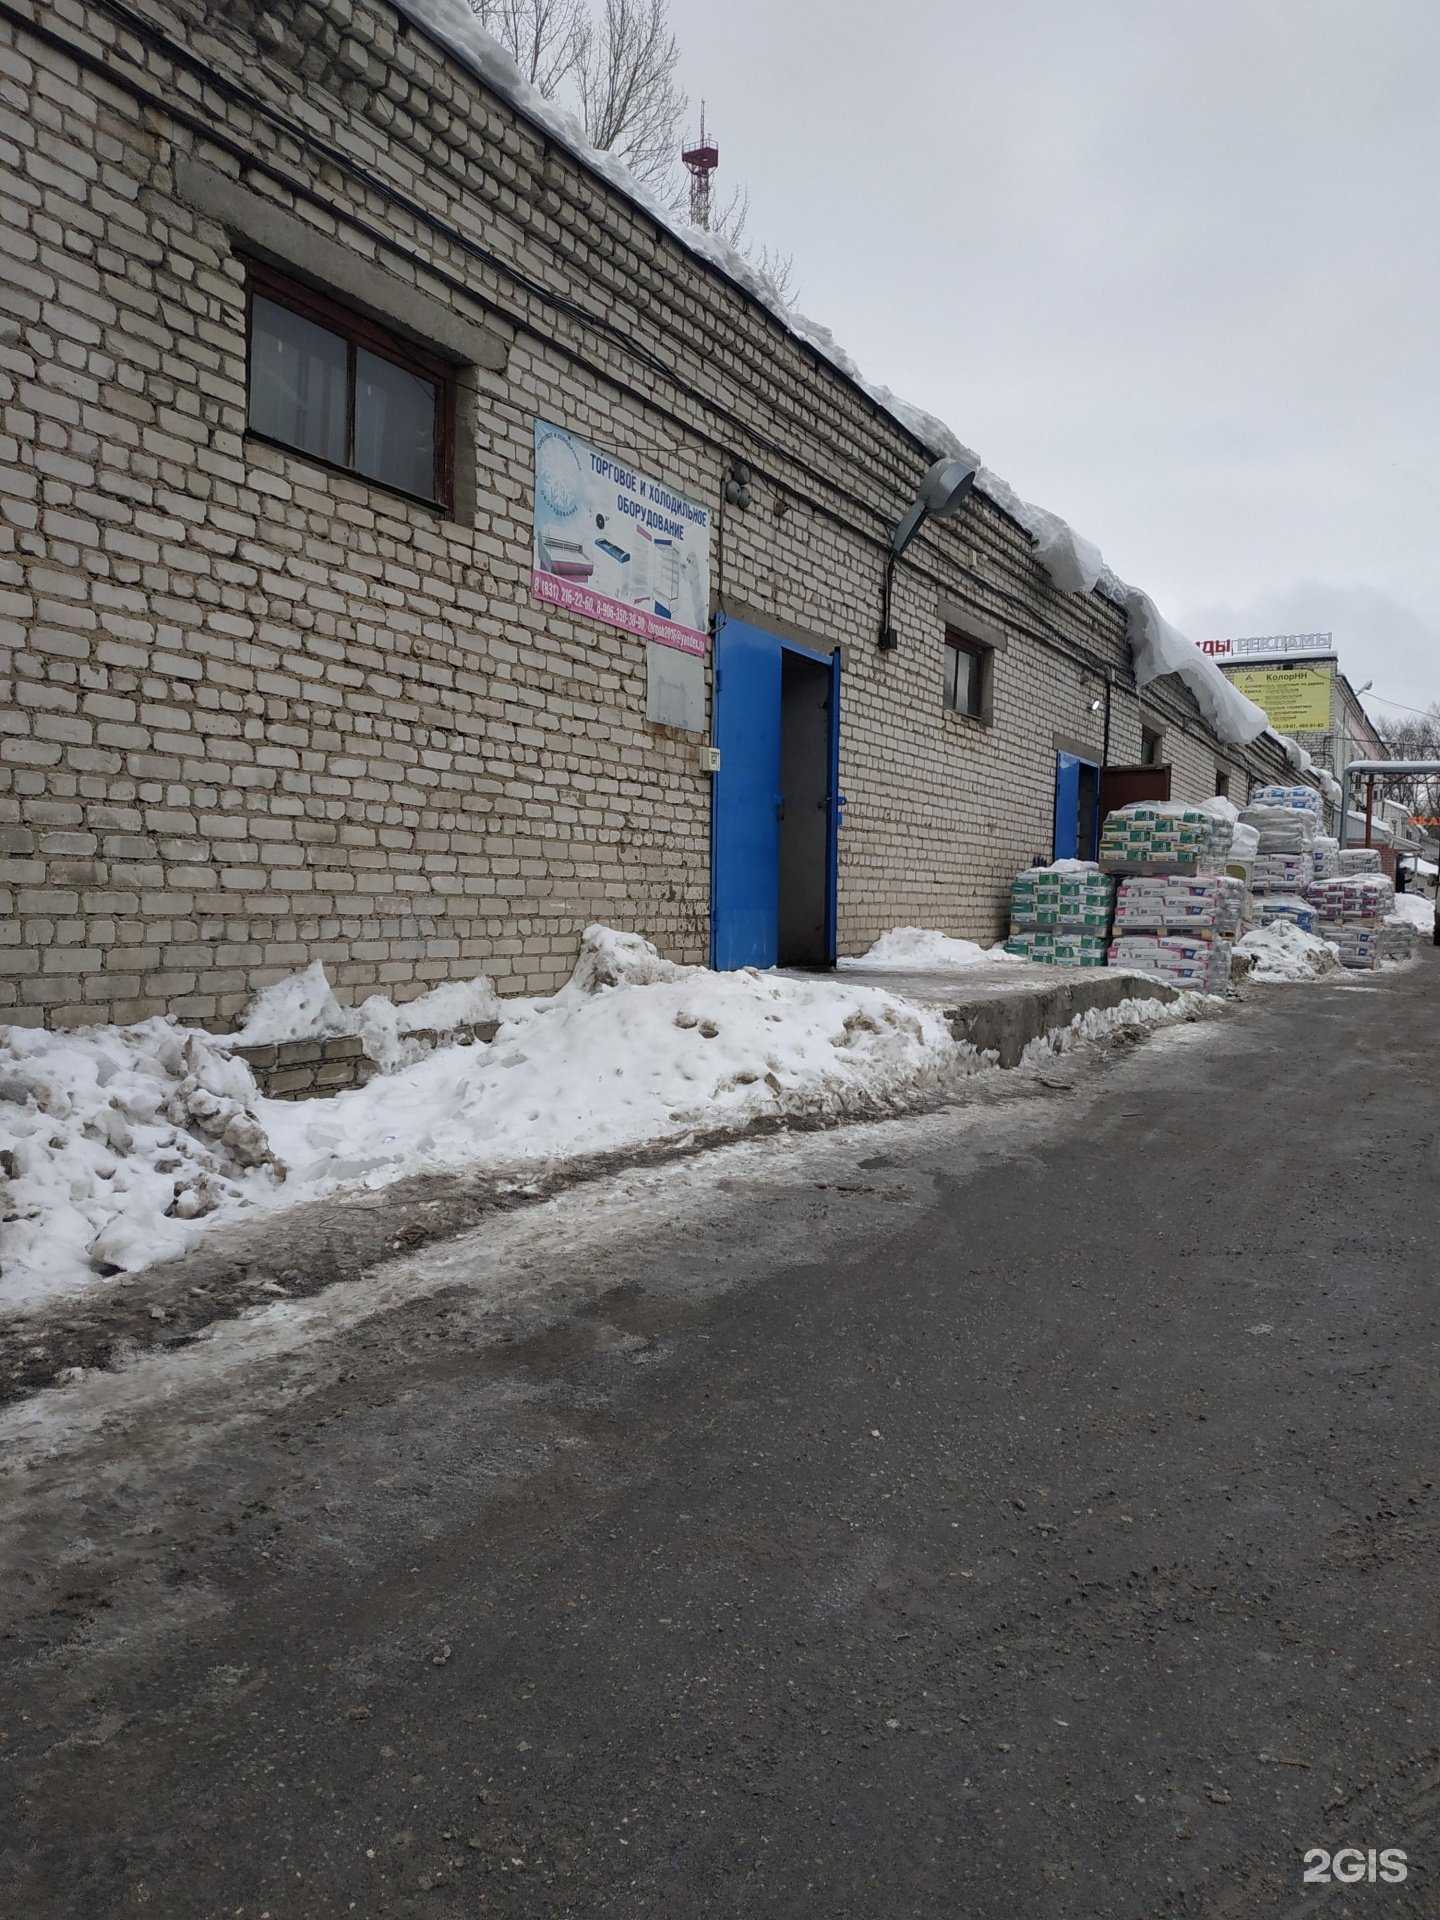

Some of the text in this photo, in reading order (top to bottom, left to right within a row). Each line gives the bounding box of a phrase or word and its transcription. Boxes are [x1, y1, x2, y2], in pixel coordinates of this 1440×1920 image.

[590, 452, 637, 493] ТОРГОВОЕ
[640, 481, 646, 498] И
[649, 484, 708, 528] ХОЛОДИЛЬНОЕ
[617, 494, 685, 541] ОБОРУДОВАНИЕ
[534, 576, 540, 593] 8
[1237, 632, 1332, 651] РЕКЛАМЫ
[1266, 672, 1308, 682] КолорНН
